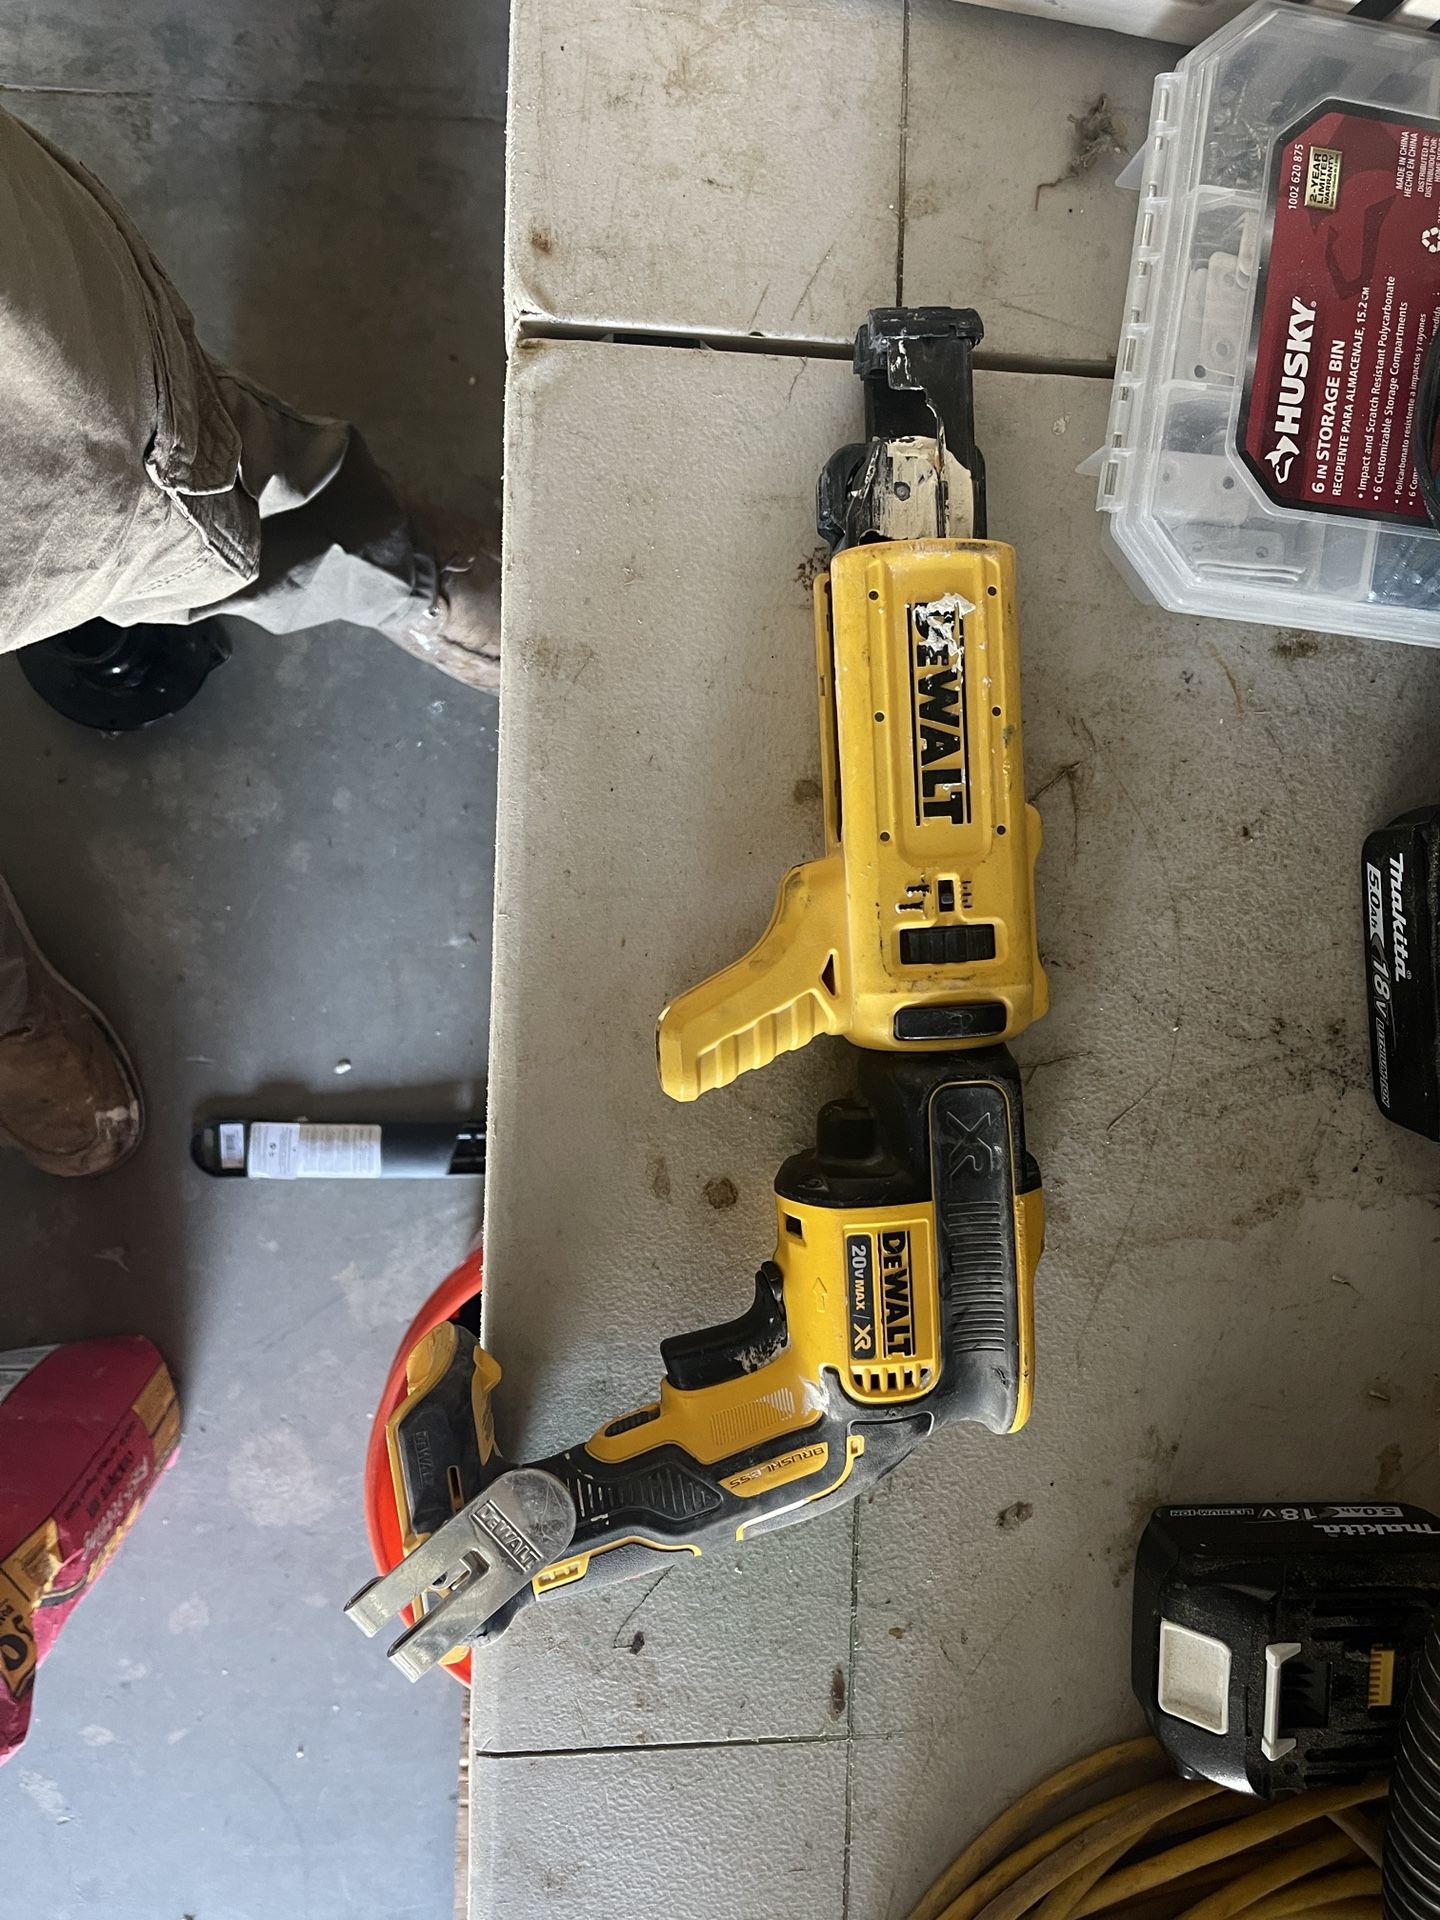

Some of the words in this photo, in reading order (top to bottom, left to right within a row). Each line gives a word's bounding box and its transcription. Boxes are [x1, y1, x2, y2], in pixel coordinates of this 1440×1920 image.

[1293, 144, 1303, 163] 875
[1398, 156, 1406, 165] IN
[1400, 131, 1409, 156] CHINA
[1408, 133, 1418, 158] CHINA
[1291, 164, 1301, 183] 620
[1310, 153, 1322, 202] 2-YEAR
[1317, 154, 1328, 204] LIMITED
[1323, 155, 1334, 205] WARRANTY
[1395, 166, 1405, 190] MADE
[1407, 158, 1415, 169] EN
[1417, 147, 1429, 193] DISTRIBUTED
[1424, 154, 1436, 198] DISTRIBUIDO
[1288, 186, 1299, 209] 1002
[1403, 170, 1414, 198] HECHO
[1356, 301, 1368, 323] 15.2
[1361, 287, 1370, 300] CM
[1378, 276, 1396, 347] Polycarbonate
[1328, 340, 1346, 372] BIN
[1390, 301, 1408, 375] Compartments
[1274, 296, 1317, 434] HUSKY
[1346, 327, 1365, 401] ALMACENAJE,
[1371, 347, 1386, 394] Resistant
[1366, 396, 1379, 433] Scratch
[1384, 377, 1399, 415] Storage
[1394, 439, 1409, 495] Policarbonato
[1404, 399, 1415, 438] resistente
[1410, 353, 1421, 391] impactos
[1416, 313, 1427, 345] rayones
[1316, 376, 1341, 460] STORAGE
[1341, 404, 1354, 433] PARA
[1364, 435, 1374, 454] and
[1374, 418, 1392, 484] Customizable
[1316, 464, 1328, 479] IN
[1332, 435, 1349, 496] RECIPIENTE
[1357, 456, 1371, 491] Impact
[1312, 482, 1325, 493] 6
[1390, 852, 1409, 982] makita
[1372, 960, 1390, 1018] 18V
[1376, 1017, 1390, 1108] LITHIUM-ION
[946, 1111, 994, 1179] XR
[881, 1230, 912, 1357] DEWALT
[853, 1322, 872, 1352] XR
[729, 1446, 826, 1490] BRUSHLESS
[1170, 1508, 1255, 1518] LITHIUM-ION
[1258, 1507, 1318, 1521] 18V
[476, 1504, 540, 1571] DEWALT
